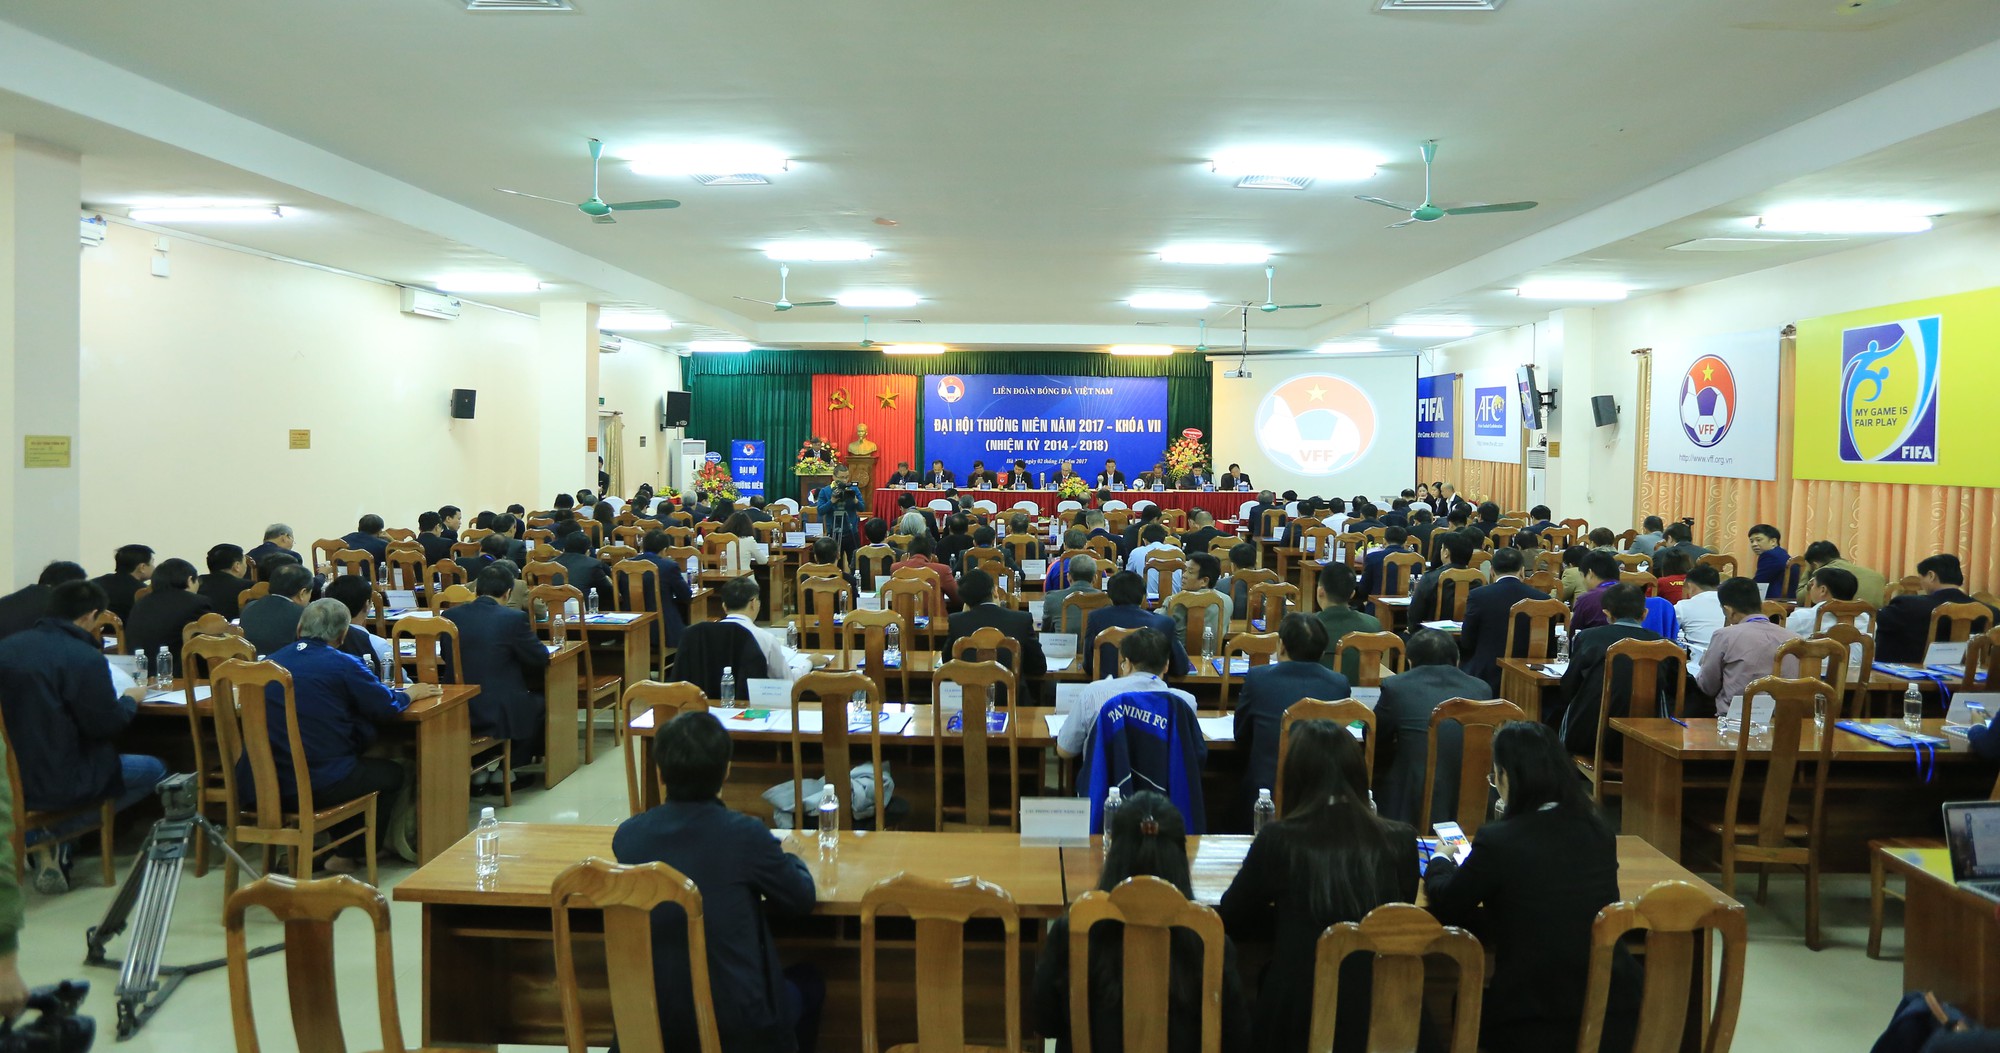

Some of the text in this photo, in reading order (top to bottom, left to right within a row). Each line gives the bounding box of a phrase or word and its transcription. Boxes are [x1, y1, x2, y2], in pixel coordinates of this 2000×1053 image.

[992, 386, 1114, 396] LIÊN ĐOÀN BÓNG ĐÁ VIỆT NAM
[1418, 397, 1444, 422] FIFA
[1475, 394, 1505, 422] AFC
[1855, 406, 1908, 417] MY GAME IS
[933, 418, 953, 435] ĐẠI
[955, 416, 974, 435] HỘI
[976, 416, 1019, 433] THƯỜNG
[1021, 416, 1048, 433] NIÊN
[1050, 416, 1076, 433] NĂM
[1078, 419, 1105, 433] 2017
[1115, 416, 1145, 433] KHÓA
[1147, 419, 1162, 433] VII
[1855, 418, 1898, 427] FAIR PLAY
[1698, 424, 1715, 435] VFF
[985, 438, 1024, 454] (NHIỆM
[1026, 437, 1040, 451] KỲ
[1043, 439, 1069, 451] 2014
[1079, 439, 1109, 452] 2018)
[1299, 449, 1334, 462] VFF
[1901, 446, 1933, 460] FIFA
[739, 466, 757, 475] ĐẠI HỘI
[1122, 704, 1153, 724] NINH
[1152, 714, 1168, 730] FC
